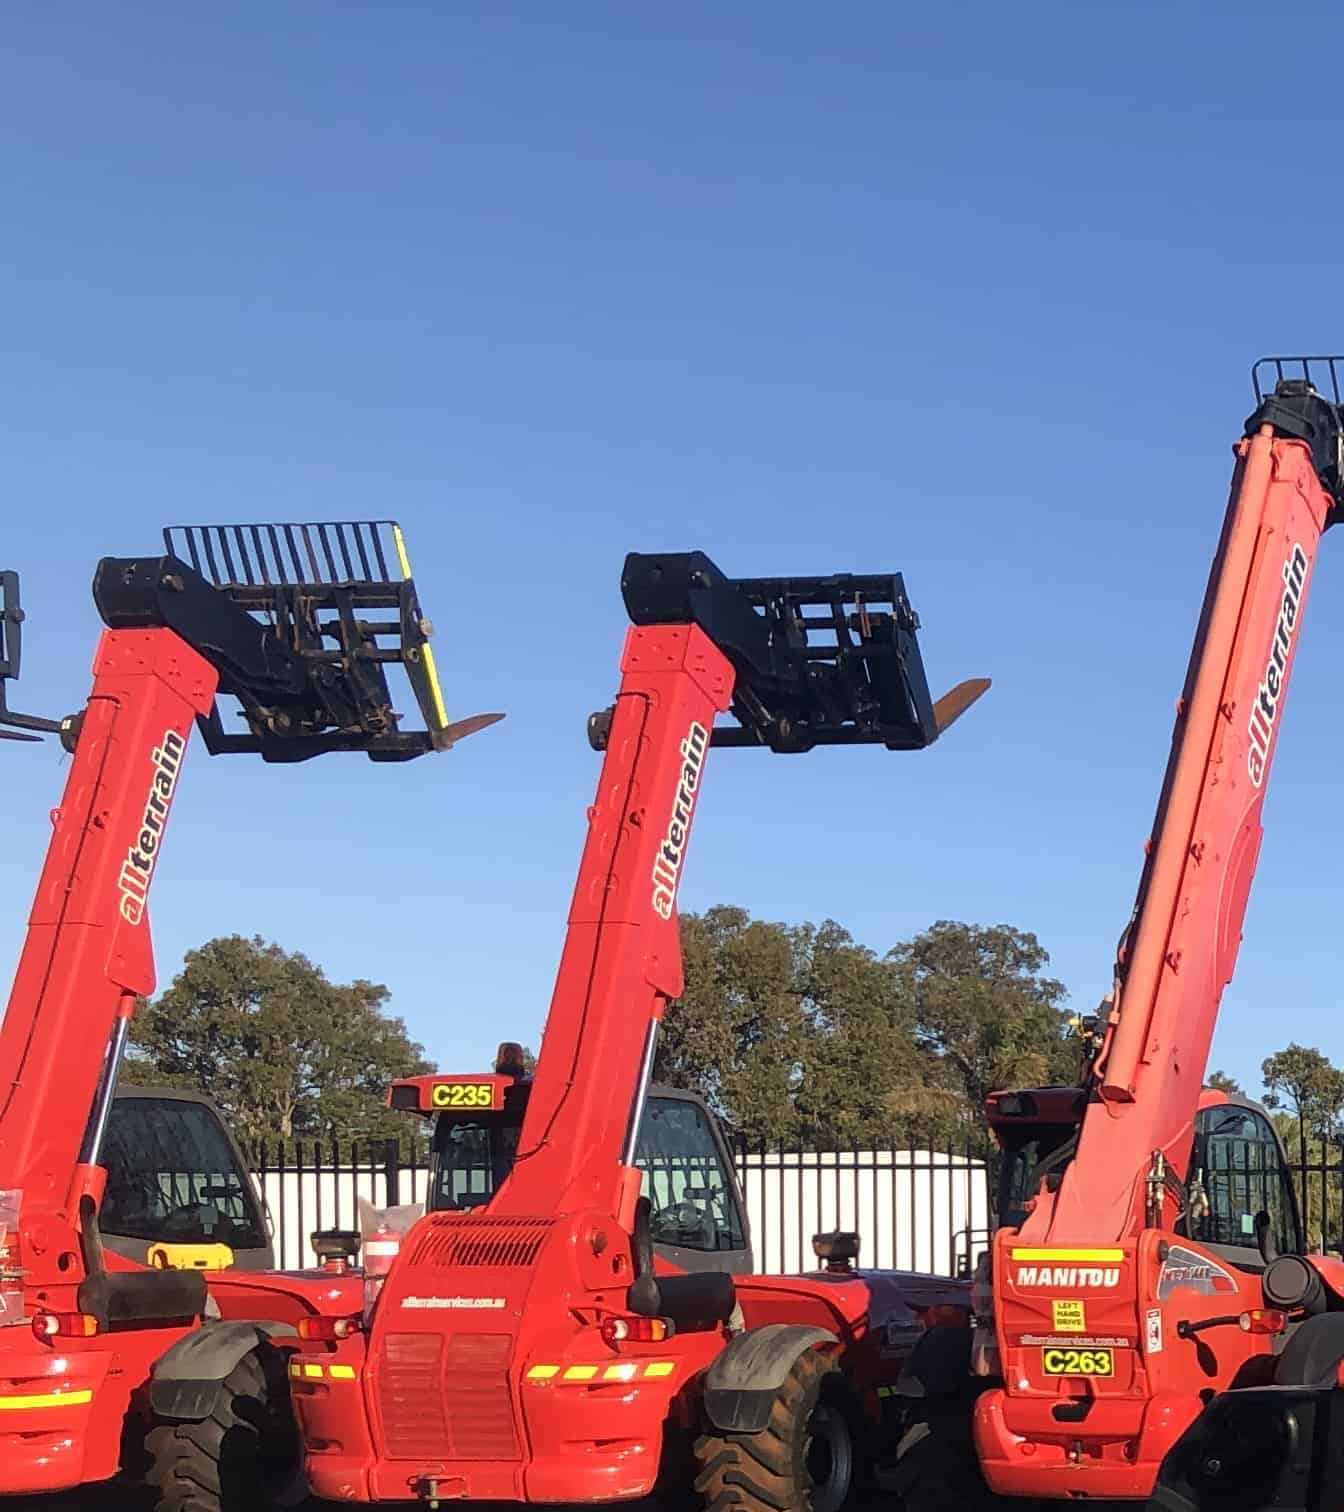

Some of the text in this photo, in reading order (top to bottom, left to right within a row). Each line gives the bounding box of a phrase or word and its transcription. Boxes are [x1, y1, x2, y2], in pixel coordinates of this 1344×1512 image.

[1248, 543, 1307, 787] allterrain
[120, 730, 185, 925] allterrain
[653, 721, 708, 920] allterrain
[433, 1085, 491, 1106] C235
[1017, 1268, 1119, 1287] MANITOU
[1044, 1351, 1110, 1374] C263
